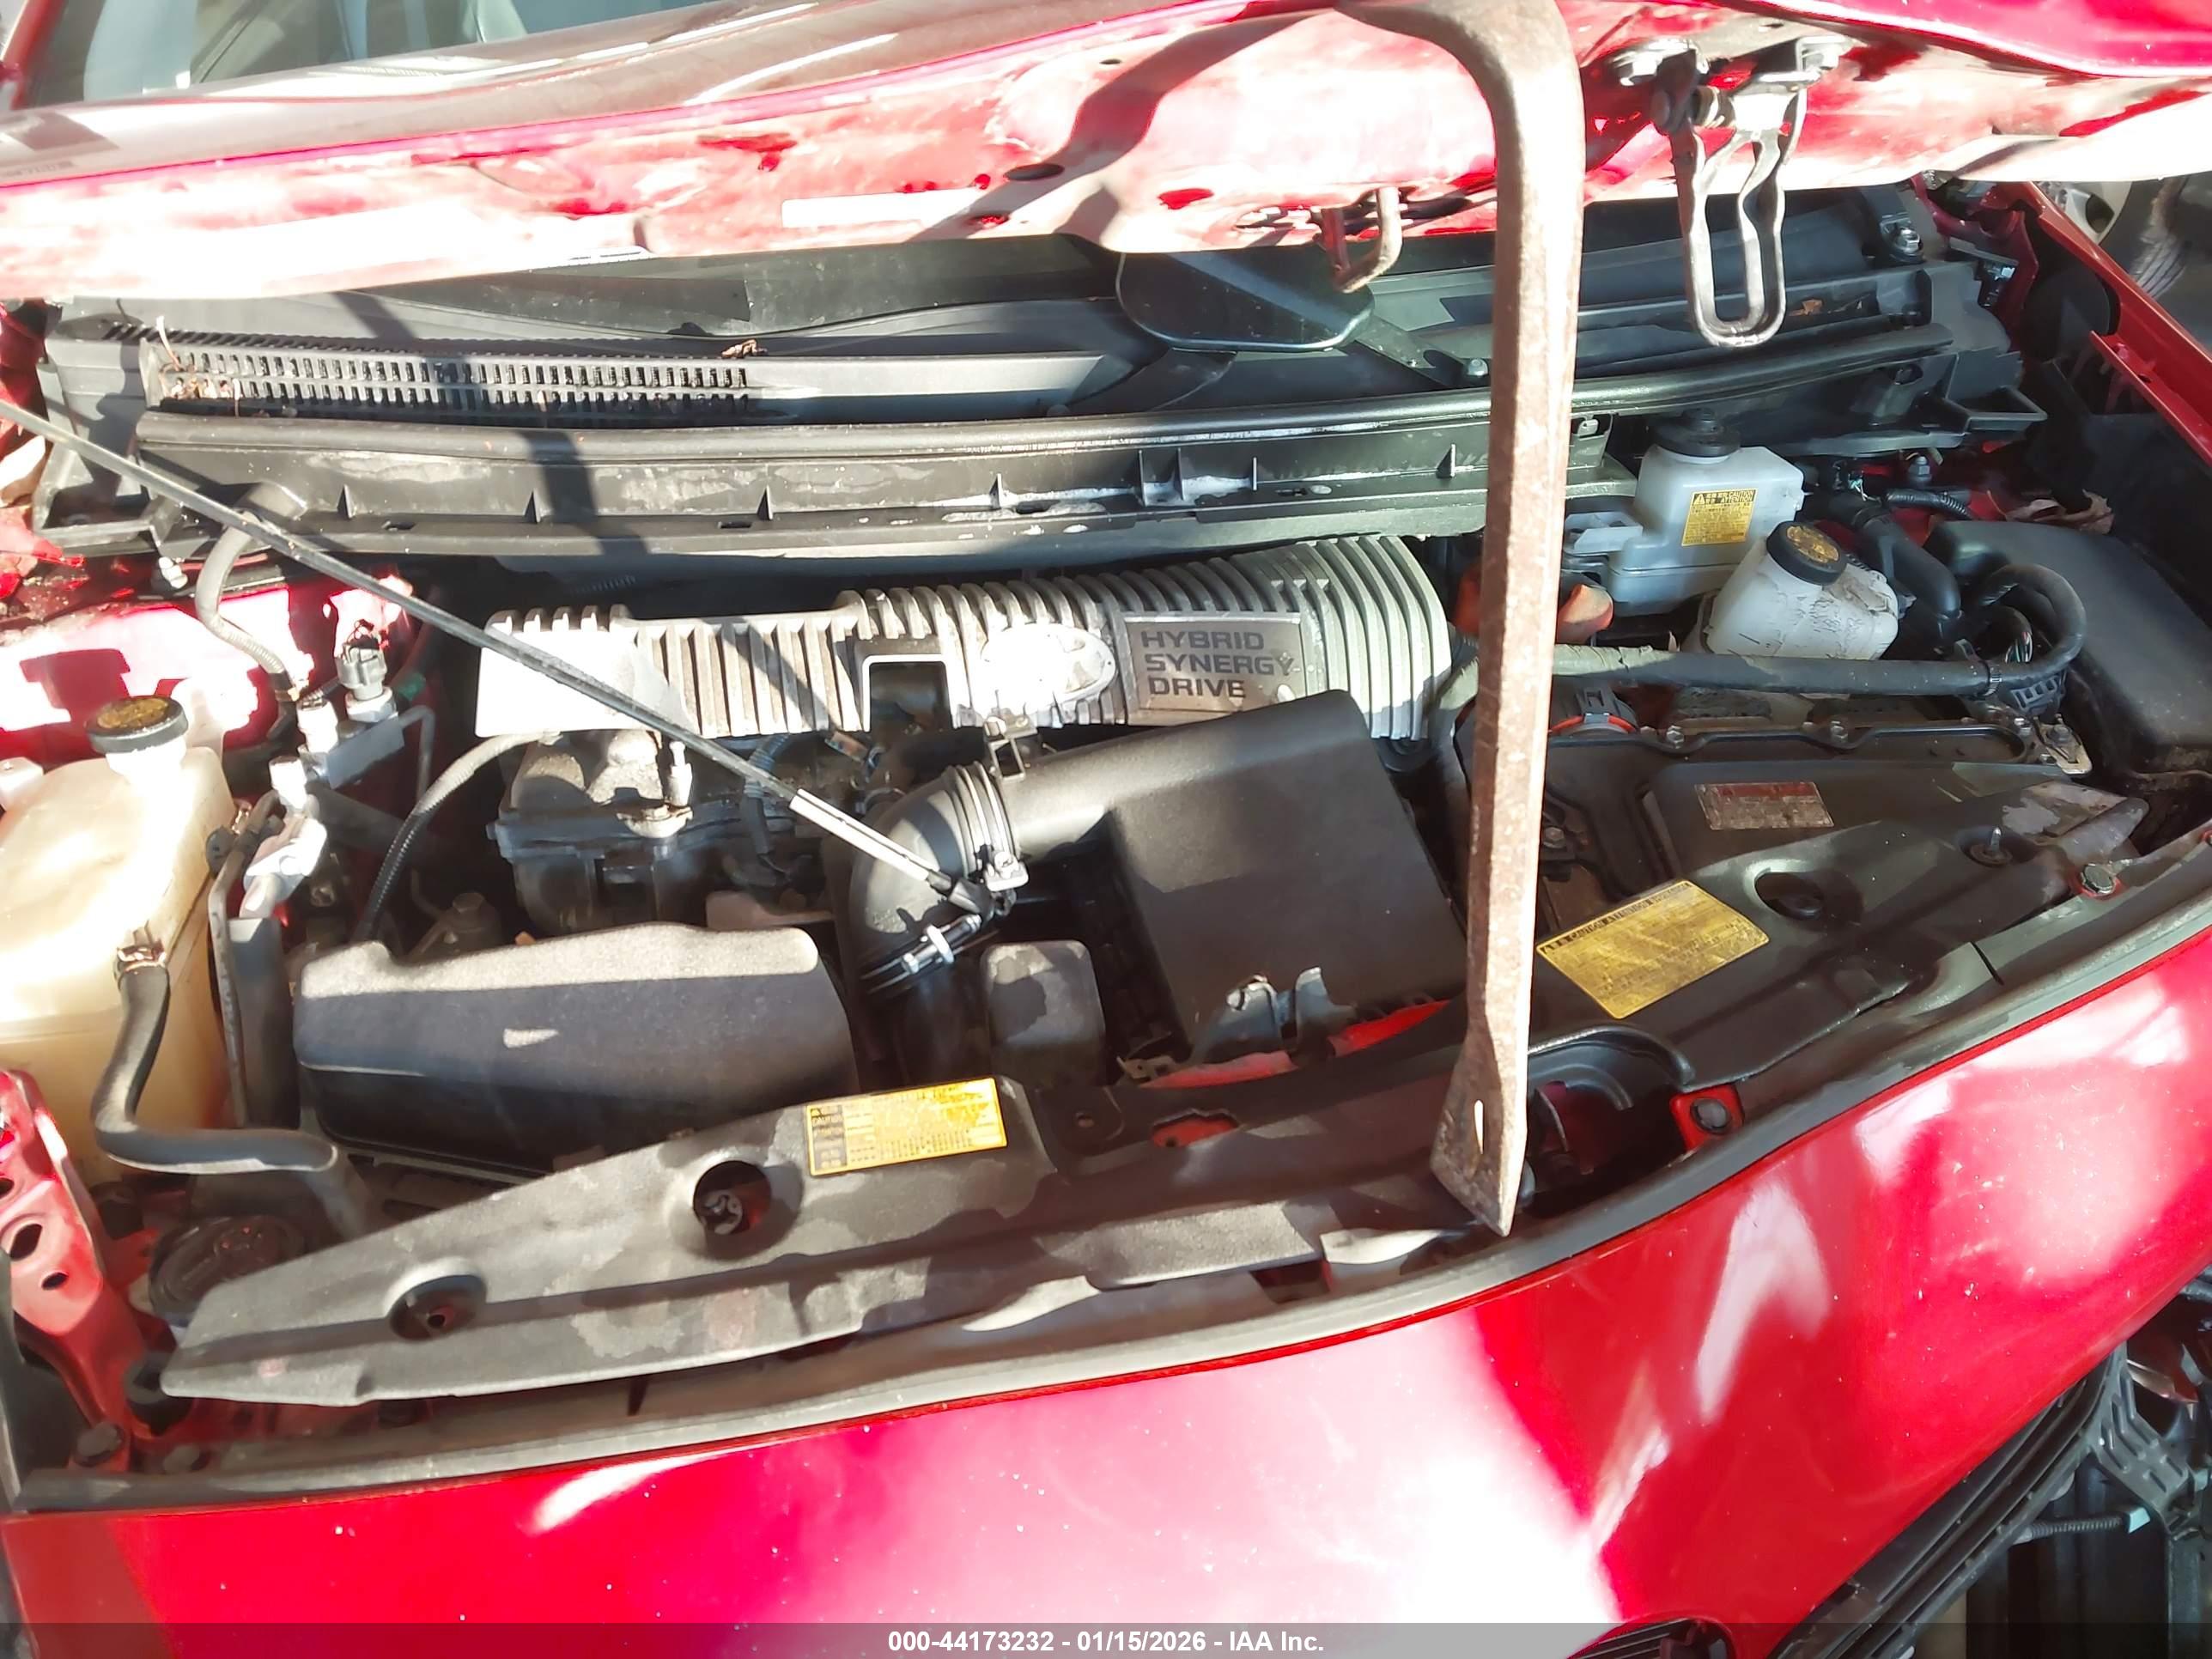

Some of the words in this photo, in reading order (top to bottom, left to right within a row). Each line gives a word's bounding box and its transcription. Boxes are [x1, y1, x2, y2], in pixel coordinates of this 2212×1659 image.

[1140, 630, 1265, 651] HYBRID
[1145, 653, 1295, 677] SYNERGY
[1148, 677, 1247, 698] DRIVE
